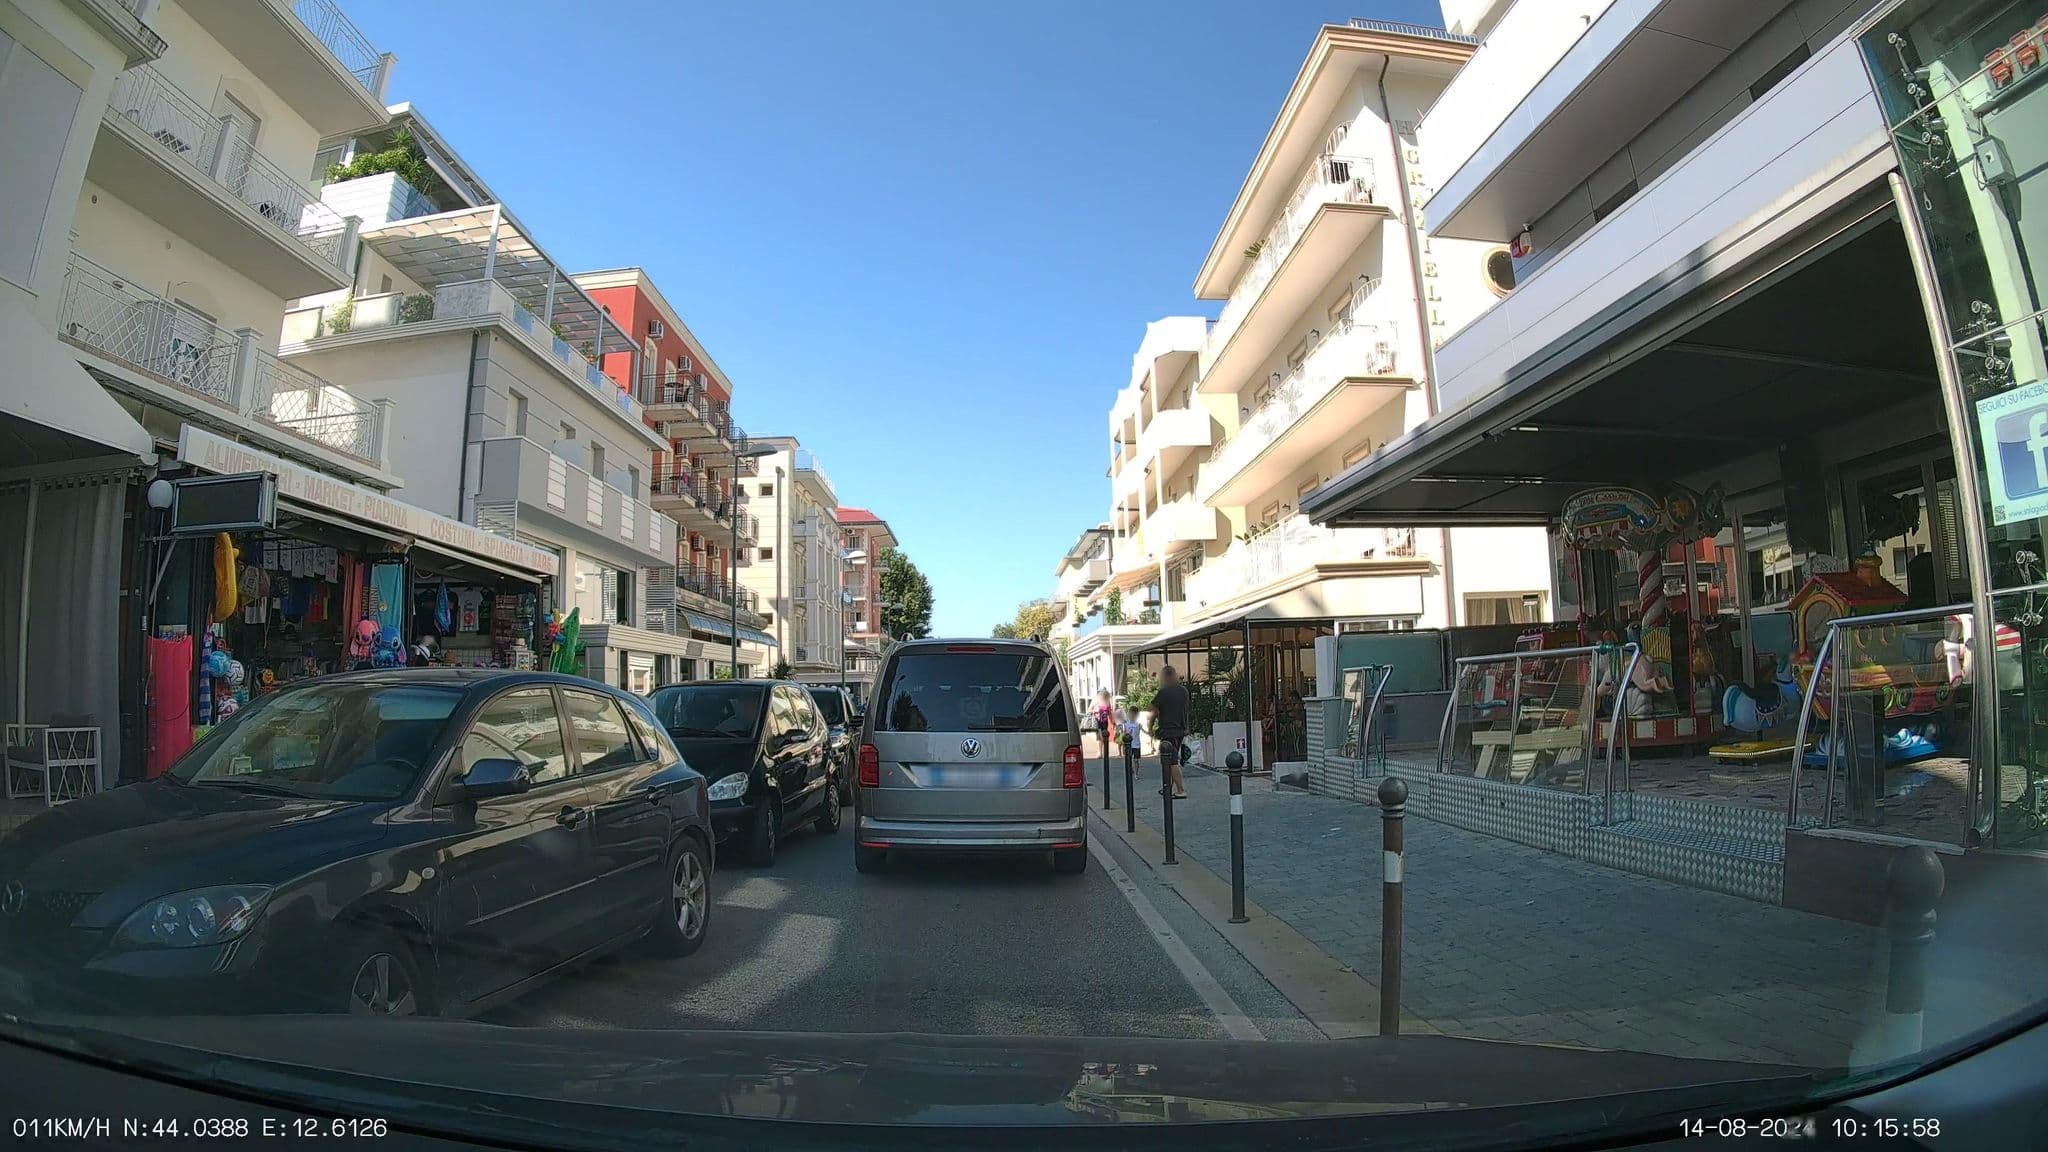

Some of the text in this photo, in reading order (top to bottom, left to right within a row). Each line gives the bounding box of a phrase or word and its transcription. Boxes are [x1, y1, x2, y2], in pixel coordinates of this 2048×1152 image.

[2008, 393, 2018, 405] SU
[204, 440, 293, 492] ALIMENRI
[304, 474, 355, 511] MARKET
[364, 495, 408, 528] PIADINA
[430, 518, 475, 547] COSTUMI
[485, 537, 523, 561] SPIAGGIA
